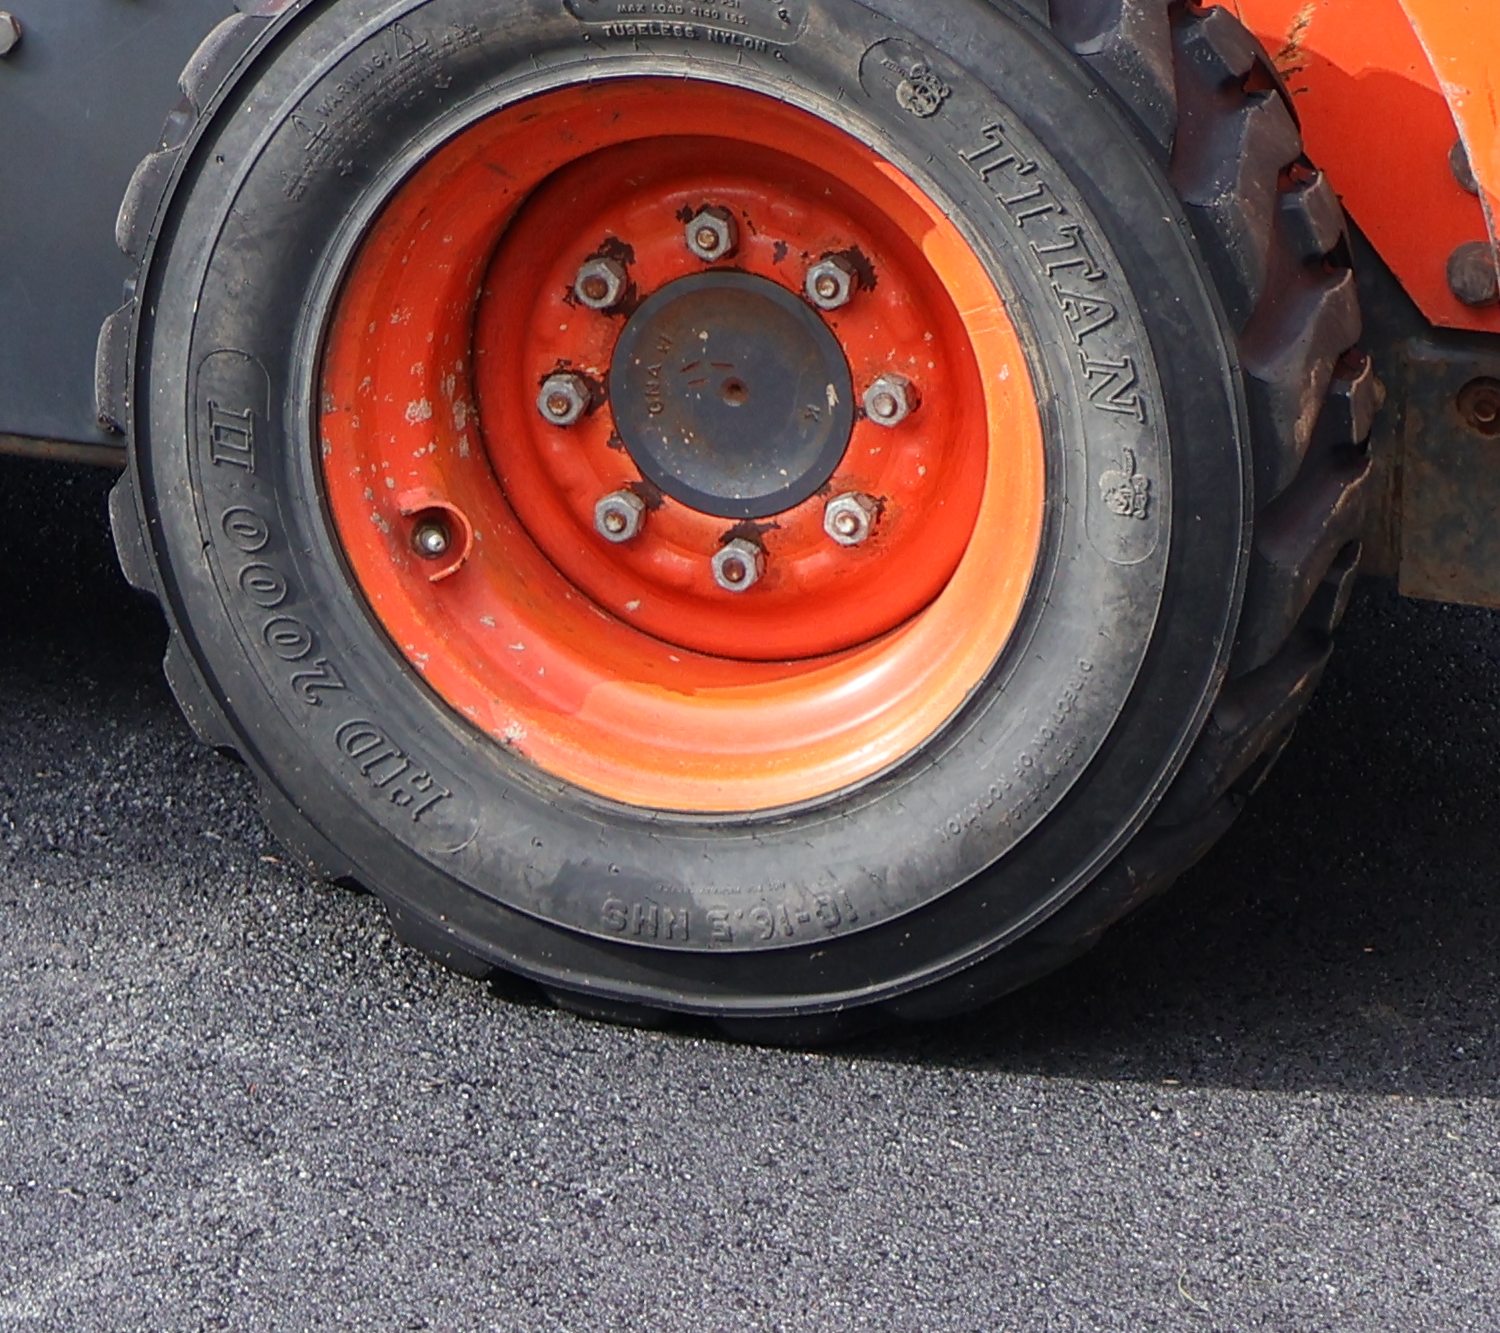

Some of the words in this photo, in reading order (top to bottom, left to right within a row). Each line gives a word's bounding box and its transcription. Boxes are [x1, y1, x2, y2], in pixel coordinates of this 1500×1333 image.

[617, 4, 646, 14] MAX
[651, 3, 683, 14] LOAD
[690, 7, 719, 19] 4140
[708, 30, 767, 53] NYLON
[958, 121, 1146, 423] TITAN
[222, 507, 346, 707] 2000
[1031, 657, 1094, 752] DIRECTION
[337, 719, 453, 823] HD
[936, 776, 1011, 843] ROTATION
[600, 897, 690, 941] NHS
